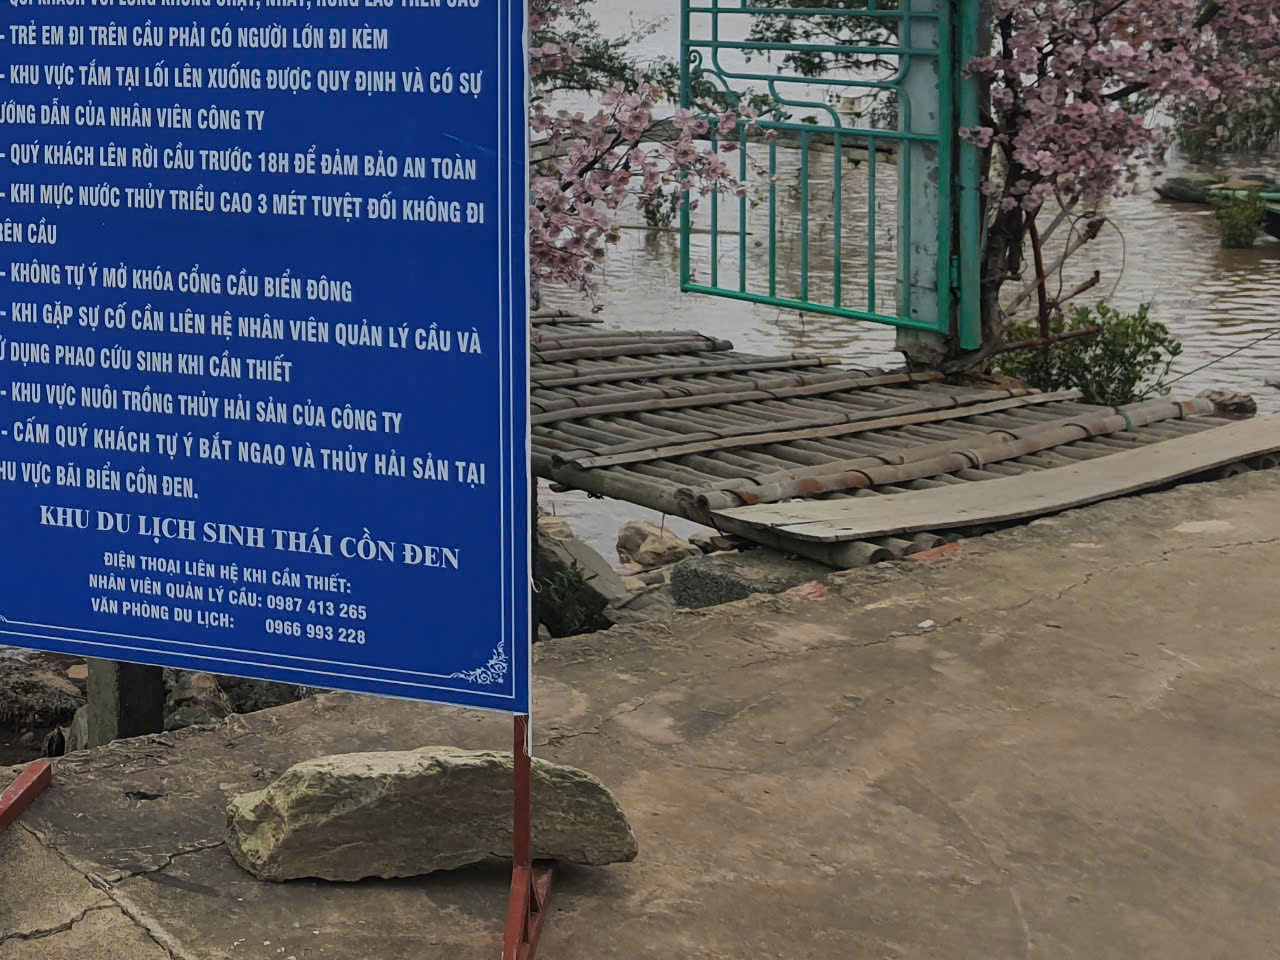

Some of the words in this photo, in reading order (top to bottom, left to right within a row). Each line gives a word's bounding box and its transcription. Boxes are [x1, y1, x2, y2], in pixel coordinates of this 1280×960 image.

[10, 20, 36, 44] TRẺ
[42, 26, 63, 44] EM
[69, 26, 83, 45] ĐI
[89, 22, 127, 45] TRÊN
[133, 20, 162, 46] CẦU
[169, 22, 204, 46] PHẢI
[211, 23, 231, 47] CÓ
[238, 23, 286, 48] NGƯỜI
[293, 23, 323, 48] LỚN
[329, 29, 346, 48] ĐI
[353, 24, 387, 49] KÈM
[11, 65, 39, 84] KHU
[44, 63, 74, 89] VỰC
[79, 59, 110, 85] TẮM
[116, 67, 139, 91] TẠI
[145, 60, 168, 87] LỐI
[175, 63, 201, 87] LÊN
[208, 62, 260, 89] XUỐNG
[266, 67, 311, 94] ĐƯỢC
[318, 70, 350, 92] QUY
[355, 71, 395, 96] ĐỊNH
[402, 67, 423, 92] VÀ
[430, 67, 453, 93] CÓ
[460, 70, 482, 98] SỰ
[41, 98, 69, 124] DẪN
[75, 100, 105, 125] CỦA
[111, 103, 151, 127] NHÂN
[157, 104, 191, 128] VIÊN
[198, 105, 240, 129] CÔNG
[246, 111, 264, 130] TY
[11, 140, 39, 165] QUÝ
[45, 141, 93, 165] KHÁCH
[100, 142, 126, 166] LÊN
[132, 144, 157, 168] RỜI
[164, 142, 193, 169] CẦU
[200, 147, 251, 171] TRƯỚC
[259, 152, 288, 172] 18H
[294, 146, 315, 173] ĐỂ
[321, 149, 357, 175] ĐẢM
[365, 150, 397, 177] BẢO
[403, 157, 425, 178] AN
[431, 154, 475, 179] TOÀN
[11, 184, 34, 203] KHI
[41, 183, 73, 208] MỰC
[79, 182, 120, 207] NƯỚC
[125, 183, 164, 208] THỦY
[170, 184, 214, 211] TRIỀU
[221, 192, 252, 213] CAO
[258, 194, 267, 213] 3
[273, 190, 306, 215] MÉT
[312, 192, 362, 222] TUYỆT
[367, 192, 396, 219] ĐỐI
[403, 196, 460, 222] KHÔNG
[466, 203, 483, 223] ĐI
[11, 259, 60, 284] KHÔNG
[65, 264, 84, 290] TỰ
[89, 263, 97, 286] Ý
[103, 263, 126, 288] MỞ
[133, 266, 173, 291] KHÓA
[179, 265, 220, 293] CỔNG
[227, 268, 258, 296] CẦU
[265, 270, 301, 298] BIỂN
[307, 275, 351, 302] ĐÔNG
[11, 342, 49, 366] DỤNG
[56, 345, 94, 367] PHAO
[101, 344, 131, 369] CỨU
[137, 351, 172, 372] SINH
[179, 354, 203, 375] KHI
[210, 350, 240, 378] CẦN
[247, 354, 292, 381] THIẾT
[14, 416, 49, 443] CẤM
[56, 423, 88, 447] QUÝ
[94, 426, 149, 452] KHÁCH
[156, 433, 177, 459] TỰ
[183, 432, 193, 456] Ý
[200, 432, 232, 460] BẮT
[239, 442, 285, 465] NGAO
[292, 443, 314, 468] VÀ
[321, 445, 367, 472] THỦY
[375, 449, 405, 476] HẢI
[413, 453, 448, 480] SẢN
[456, 461, 484, 488] TẠI
[22, 461, 50, 487] VỰC
[57, 463, 80, 486] BÃI
[87, 462, 120, 490] BIỂN
[126, 466, 157, 494] CỒN
[162, 476, 198, 498] ĐEN.
[40, 506, 89, 528] KHU
[97, 511, 130, 533] DU
[139, 516, 195, 543] LỊCH
[204, 523, 264, 547] SINH
[272, 528, 332, 555] THÁI
[340, 528, 395, 561] CỒN
[403, 544, 459, 569] ĐEN
[104, 551, 135, 568] ĐIỆN
[140, 556, 180, 576] THOẠI
[186, 560, 214, 577] LIÊN
[221, 563, 238, 583] HỆ
[244, 568, 266, 583] KHI
[272, 568, 300, 587] CẦN
[90, 573, 125, 591] NHÂN
[130, 577, 161, 595] VIÊN
[166, 582, 203, 600] QUẢN
[209, 586, 224, 602] LÝ
[267, 595, 302, 611] 0987
[308, 600, 334, 615] 413
[340, 604, 366, 619] 265
[92, 596, 117, 613] VĂN
[123, 602, 168, 620] PHÒNG
[174, 608, 192, 622] DU
[266, 619, 301, 636] 0966
[307, 624, 333, 640] 993
[339, 628, 365, 644] 228
